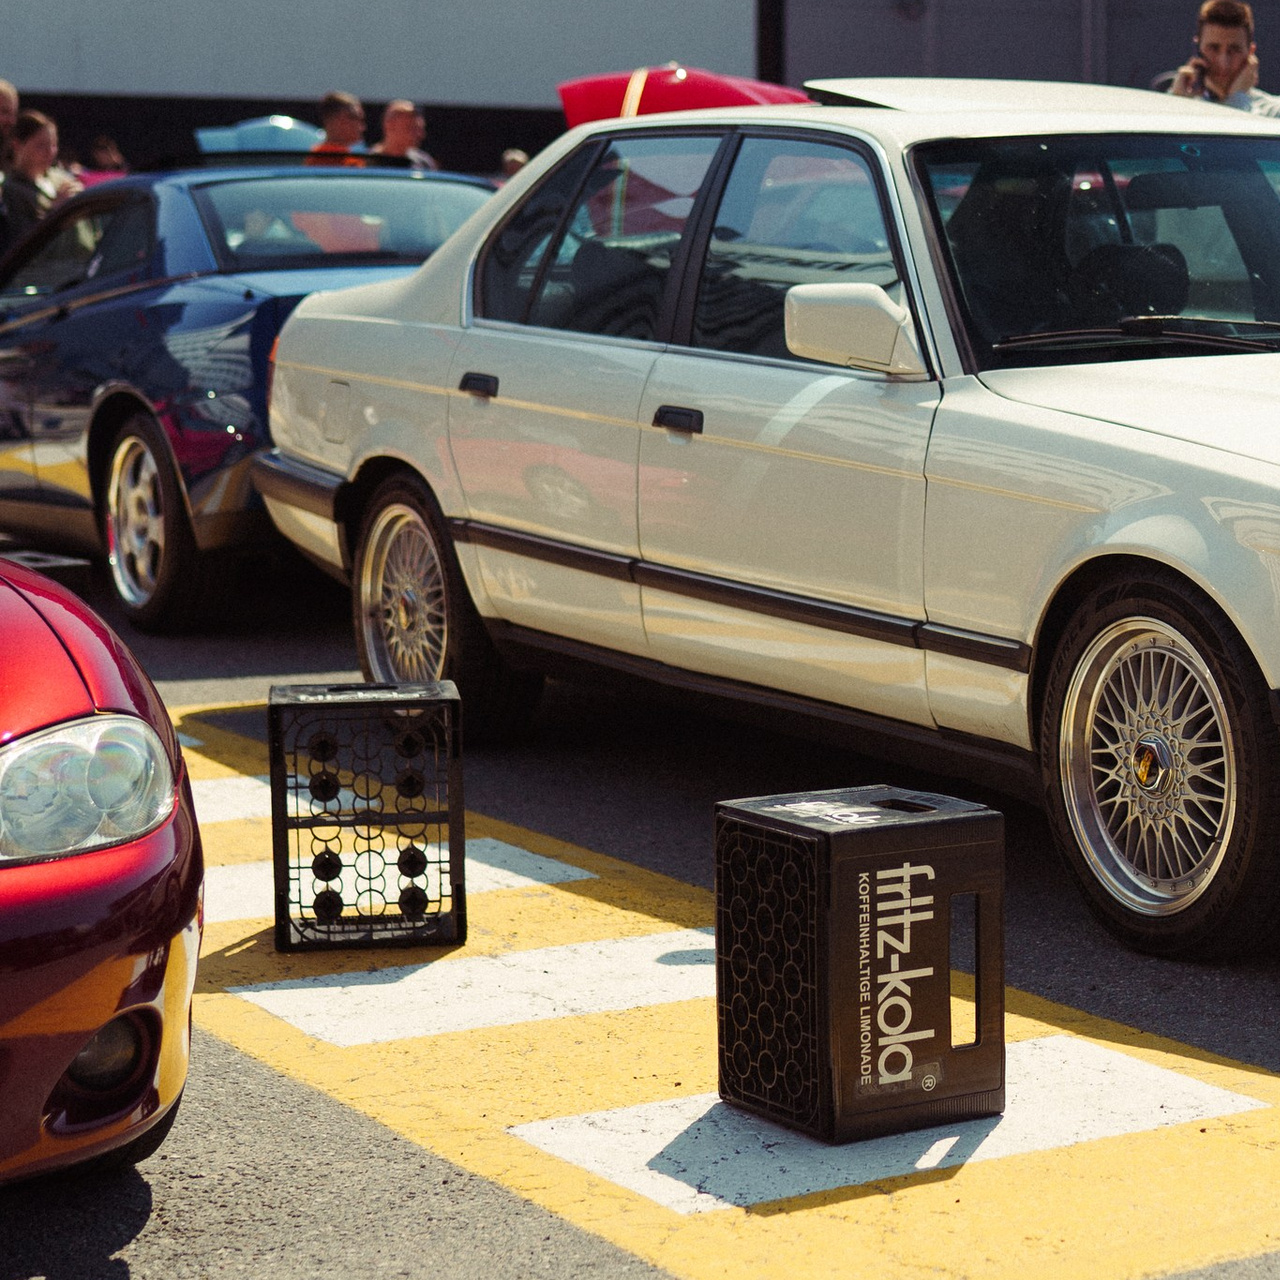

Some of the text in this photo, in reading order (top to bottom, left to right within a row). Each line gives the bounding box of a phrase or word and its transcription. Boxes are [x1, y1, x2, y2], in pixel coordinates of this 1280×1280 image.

[858, 872, 871, 1085] KOFFEINHALTIGE LIMONADE
[876, 862, 936, 1085] fritz-kola
